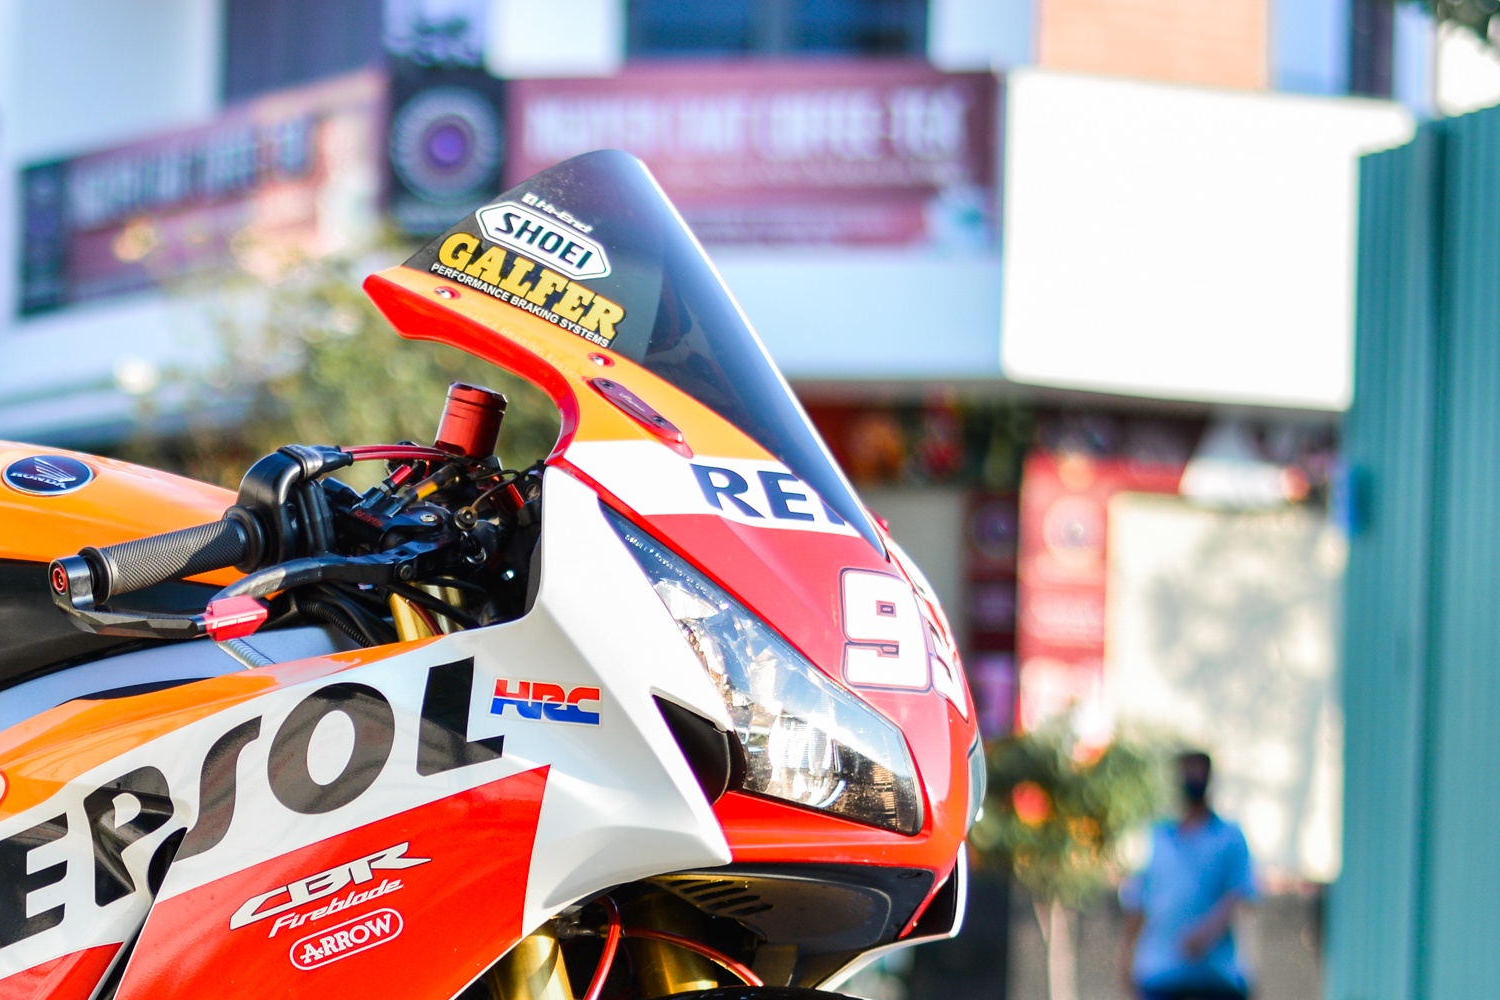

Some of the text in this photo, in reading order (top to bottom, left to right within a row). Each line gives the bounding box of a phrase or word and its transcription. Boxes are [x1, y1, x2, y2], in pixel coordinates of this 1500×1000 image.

[494, 212, 593, 270] SHOEI
[430, 263, 610, 349] PERFORMANCE BRAKING SYSTEMS
[438, 232, 625, 340] GALFER
[10, 472, 67, 489] HONDA
[492, 678, 600, 725] HRC
[229, 841, 432, 931] CBR
[268, 879, 405, 938] Fireblade
[300, 913, 392, 964] ARROW
